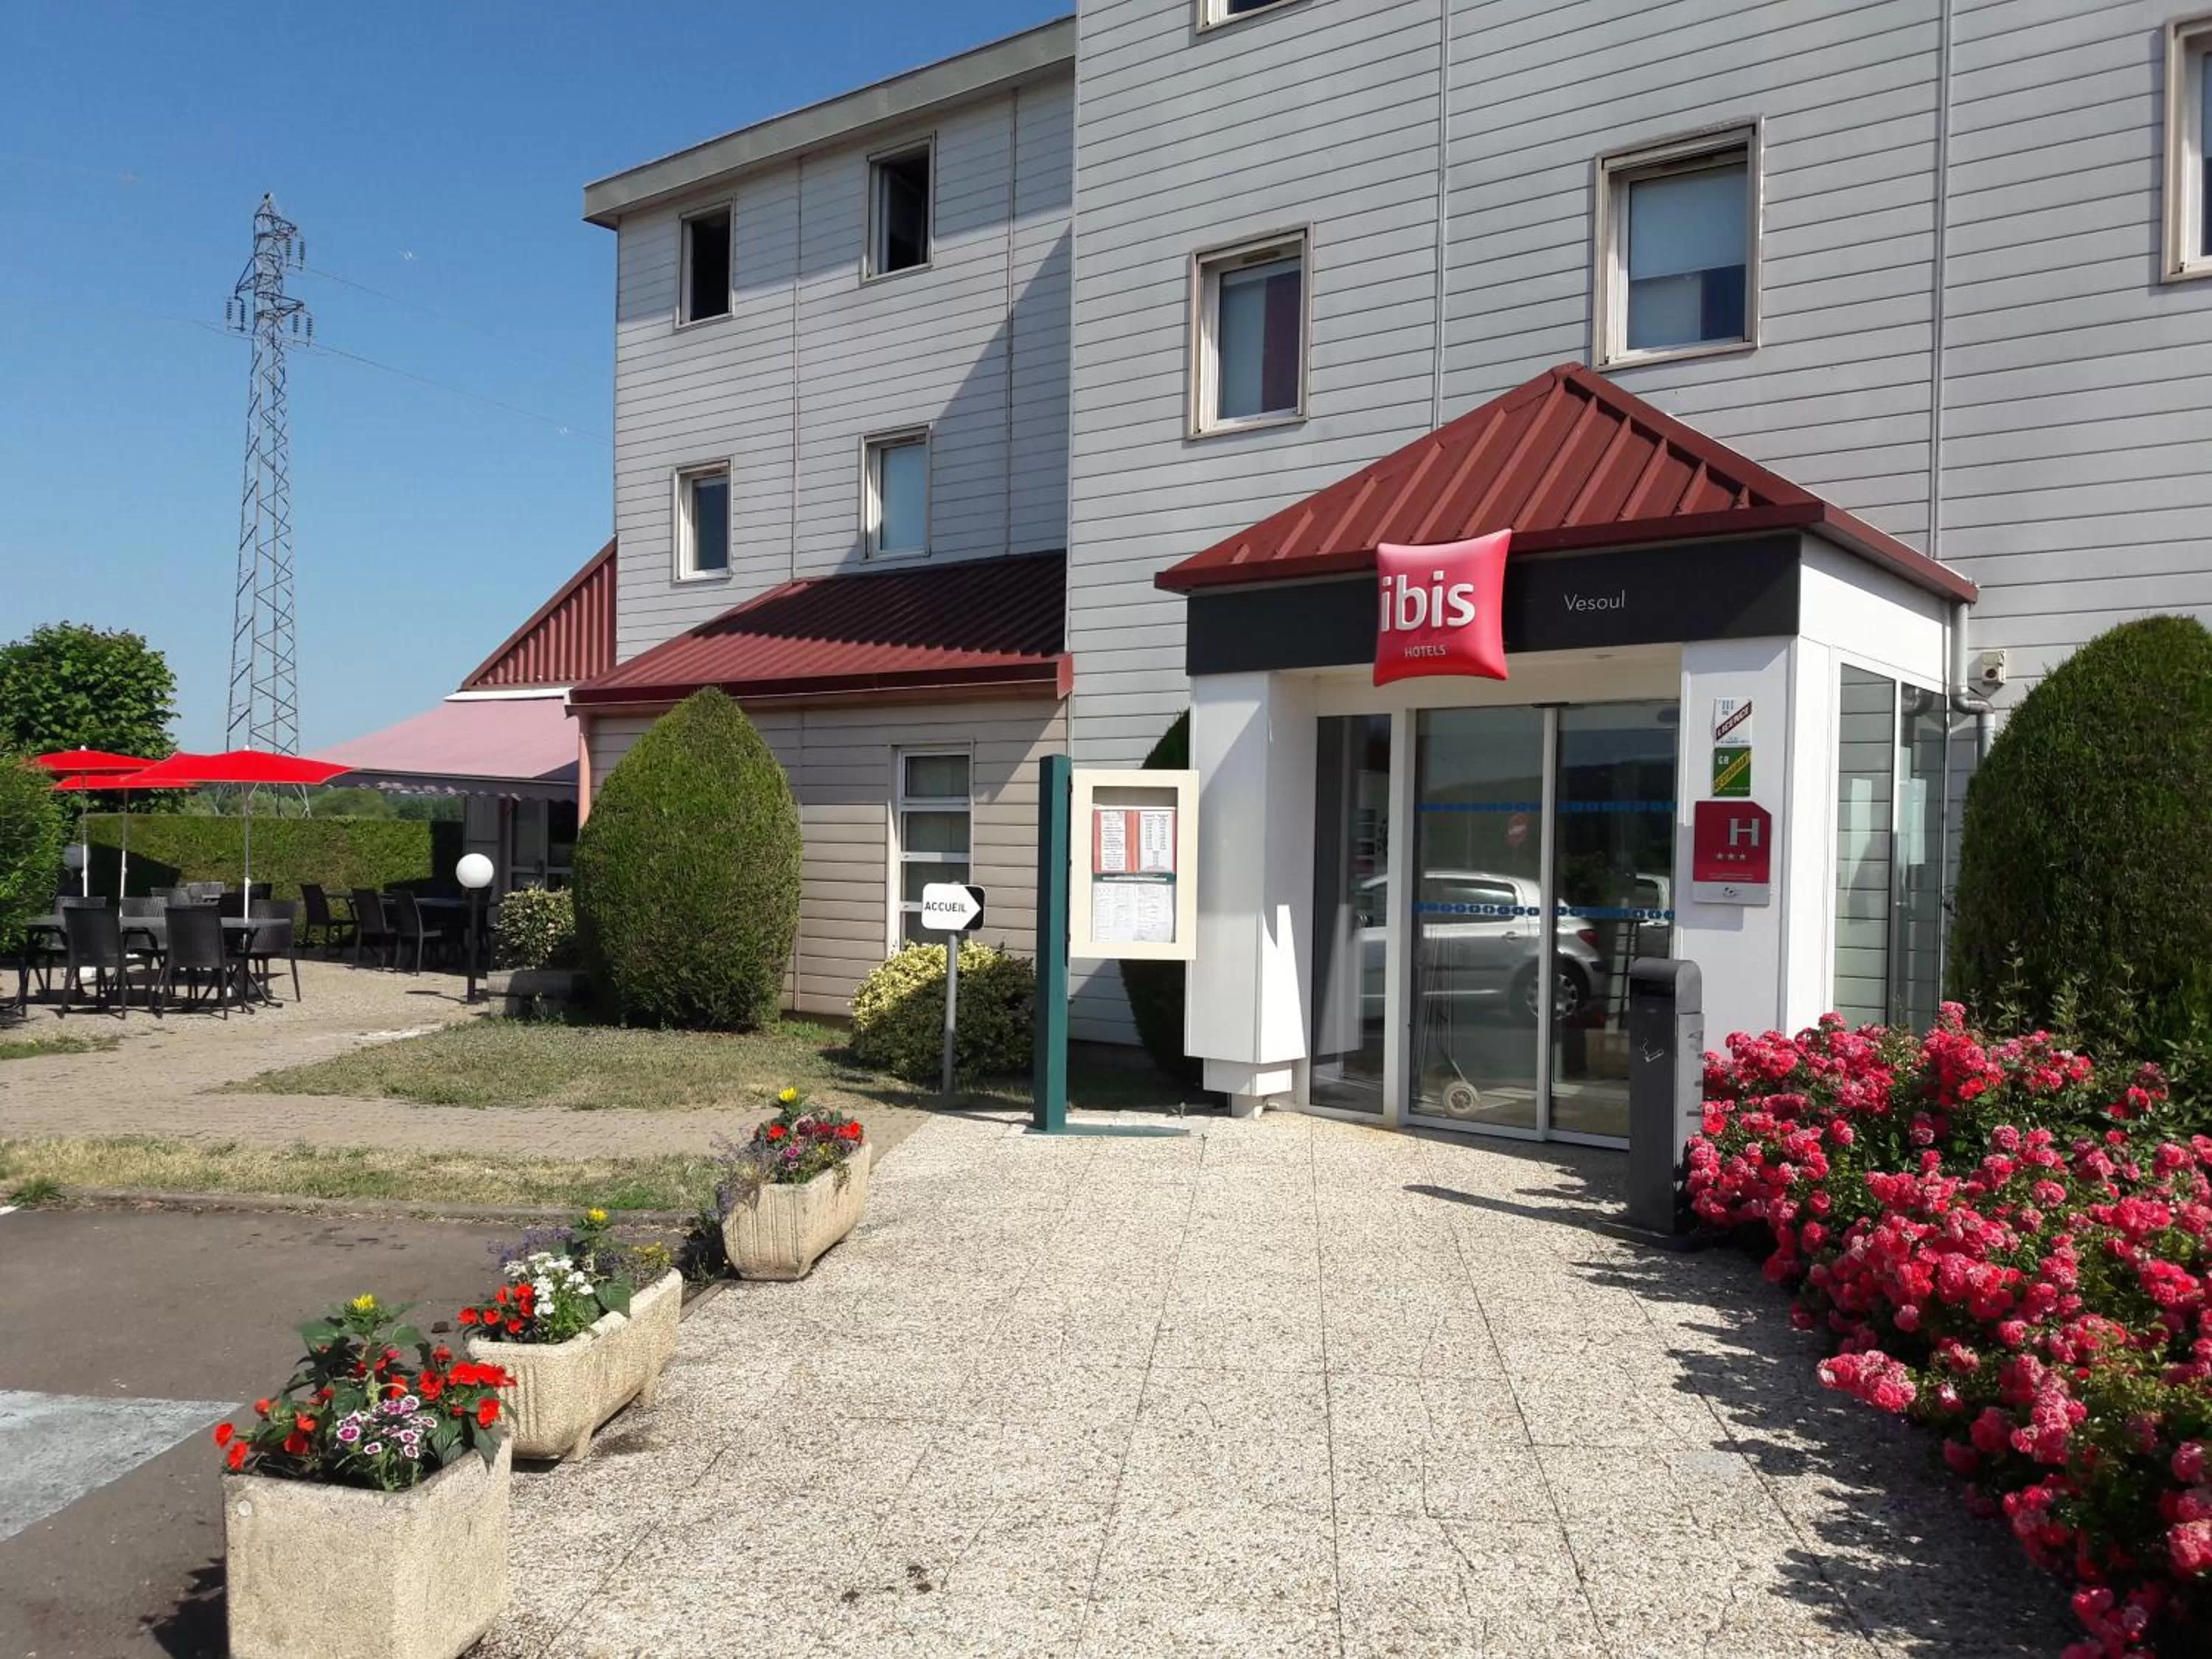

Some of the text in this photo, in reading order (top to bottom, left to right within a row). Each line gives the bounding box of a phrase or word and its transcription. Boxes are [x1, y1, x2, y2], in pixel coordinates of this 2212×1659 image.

[1381, 570, 1475, 632] ibis
[1564, 589, 1625, 611] Vesoul
[1404, 644, 1447, 658] HOTELS
[1729, 818, 1759, 846] H
[924, 901, 967, 913] ACCUEIL
